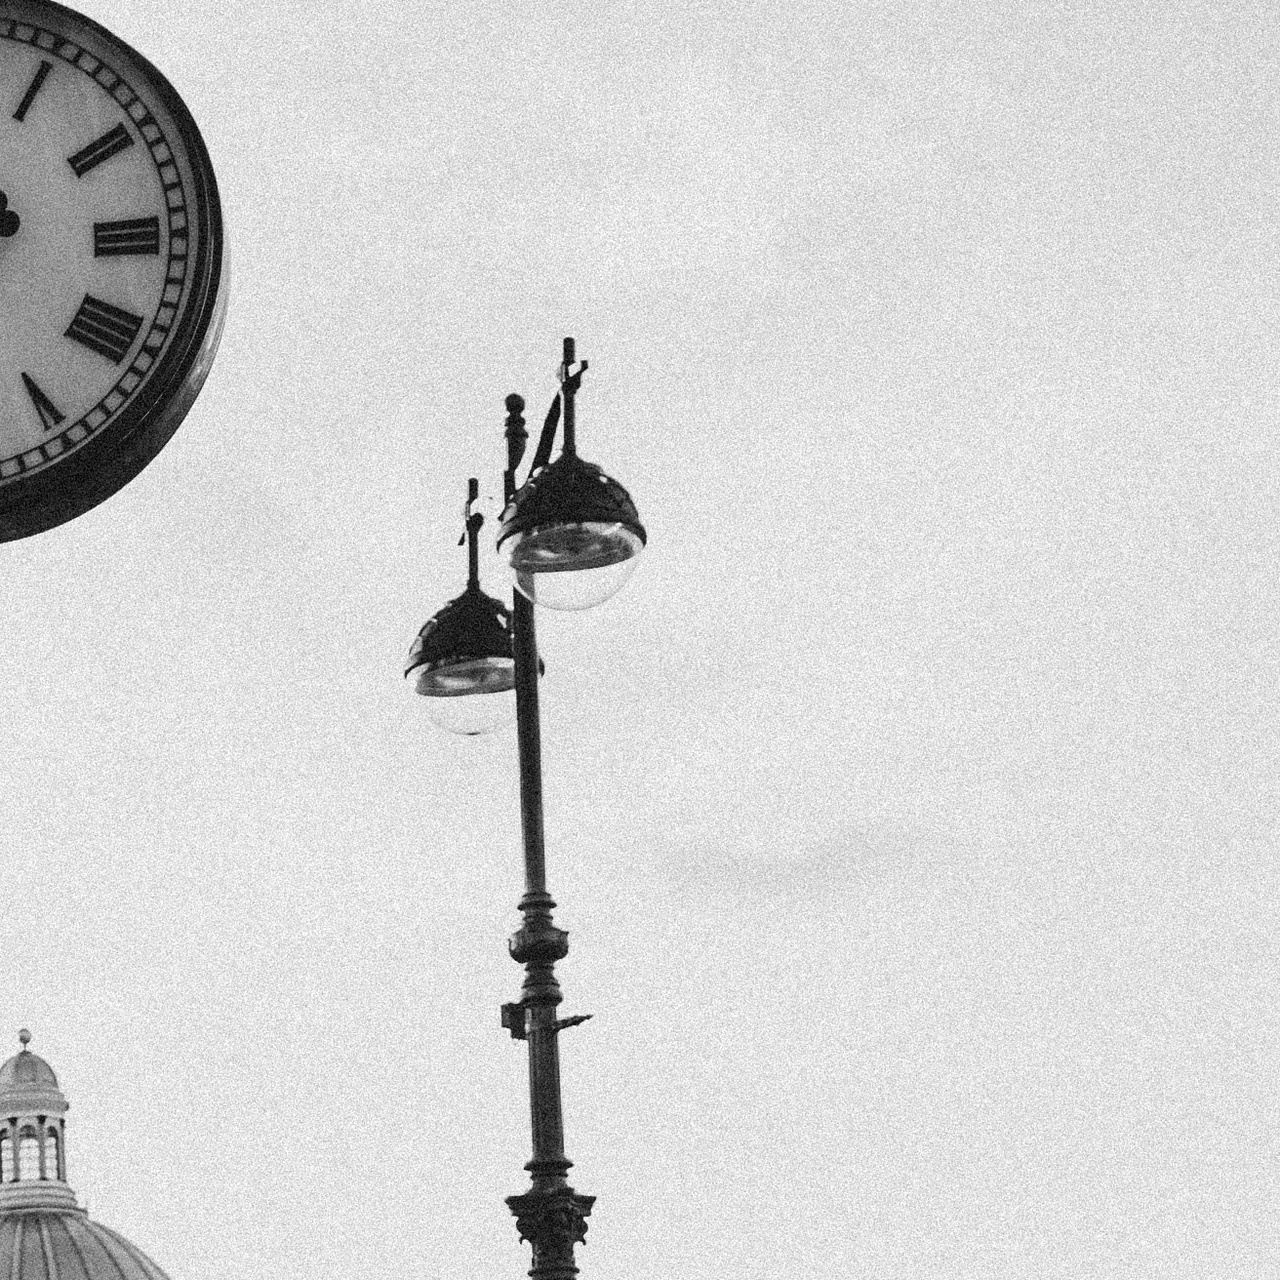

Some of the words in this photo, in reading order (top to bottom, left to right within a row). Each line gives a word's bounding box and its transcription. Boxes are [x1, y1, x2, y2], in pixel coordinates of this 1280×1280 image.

[12, 60, 53, 122] I
[67, 122, 135, 178] II
[93, 216, 160, 258] III
[64, 294, 142, 364] IIII
[21, 371, 66, 432] V
